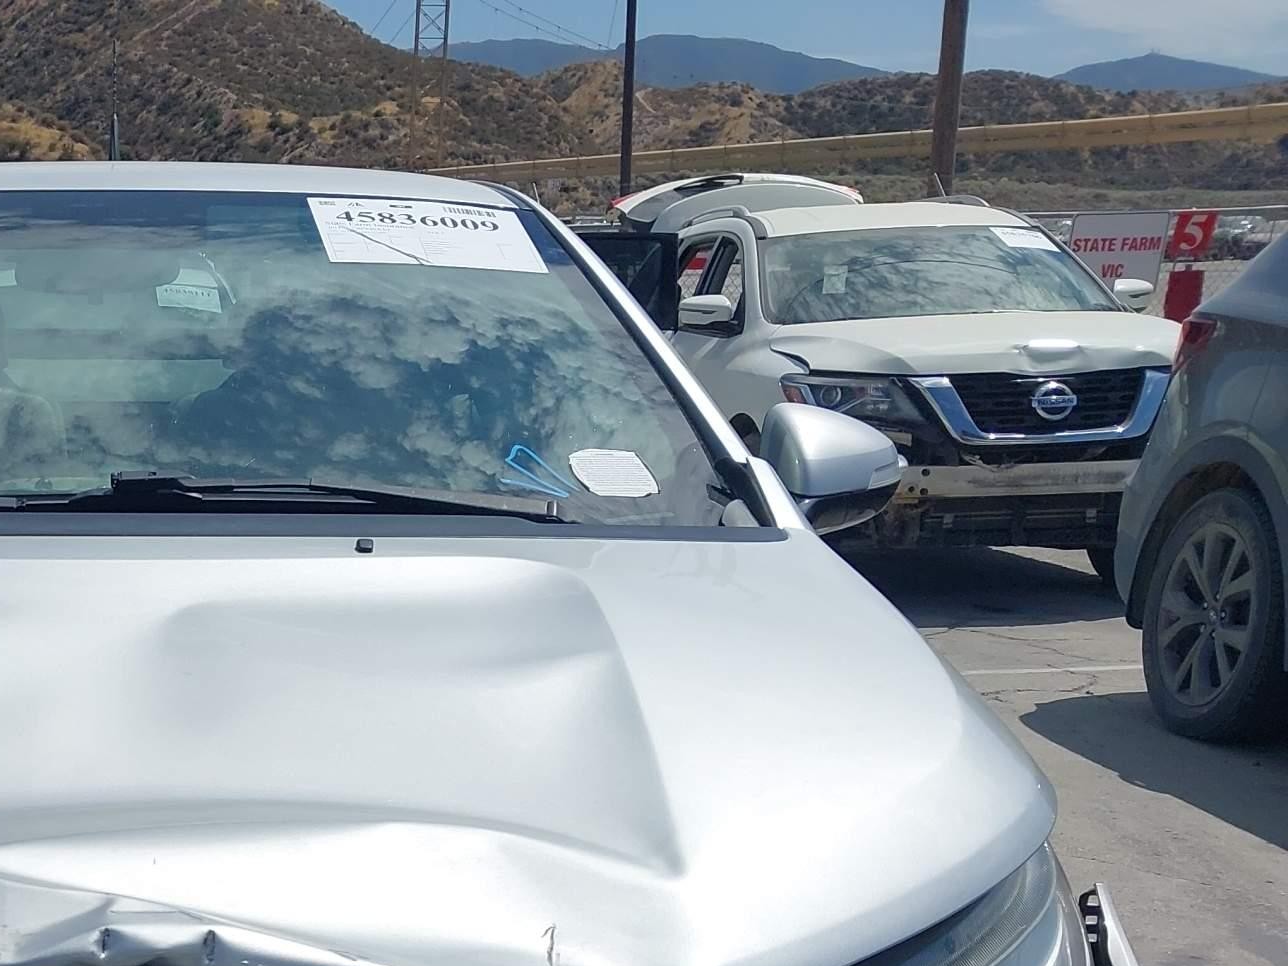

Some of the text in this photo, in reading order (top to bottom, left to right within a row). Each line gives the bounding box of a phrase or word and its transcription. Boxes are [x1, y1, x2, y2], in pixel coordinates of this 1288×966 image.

[336, 211, 499, 231] 45836009
[1179, 214, 1208, 250] 5
[1072, 236, 1162, 252] STATE FARM
[1101, 263, 1124, 278] VIC
[1037, 397, 1074, 406] NISSAN
